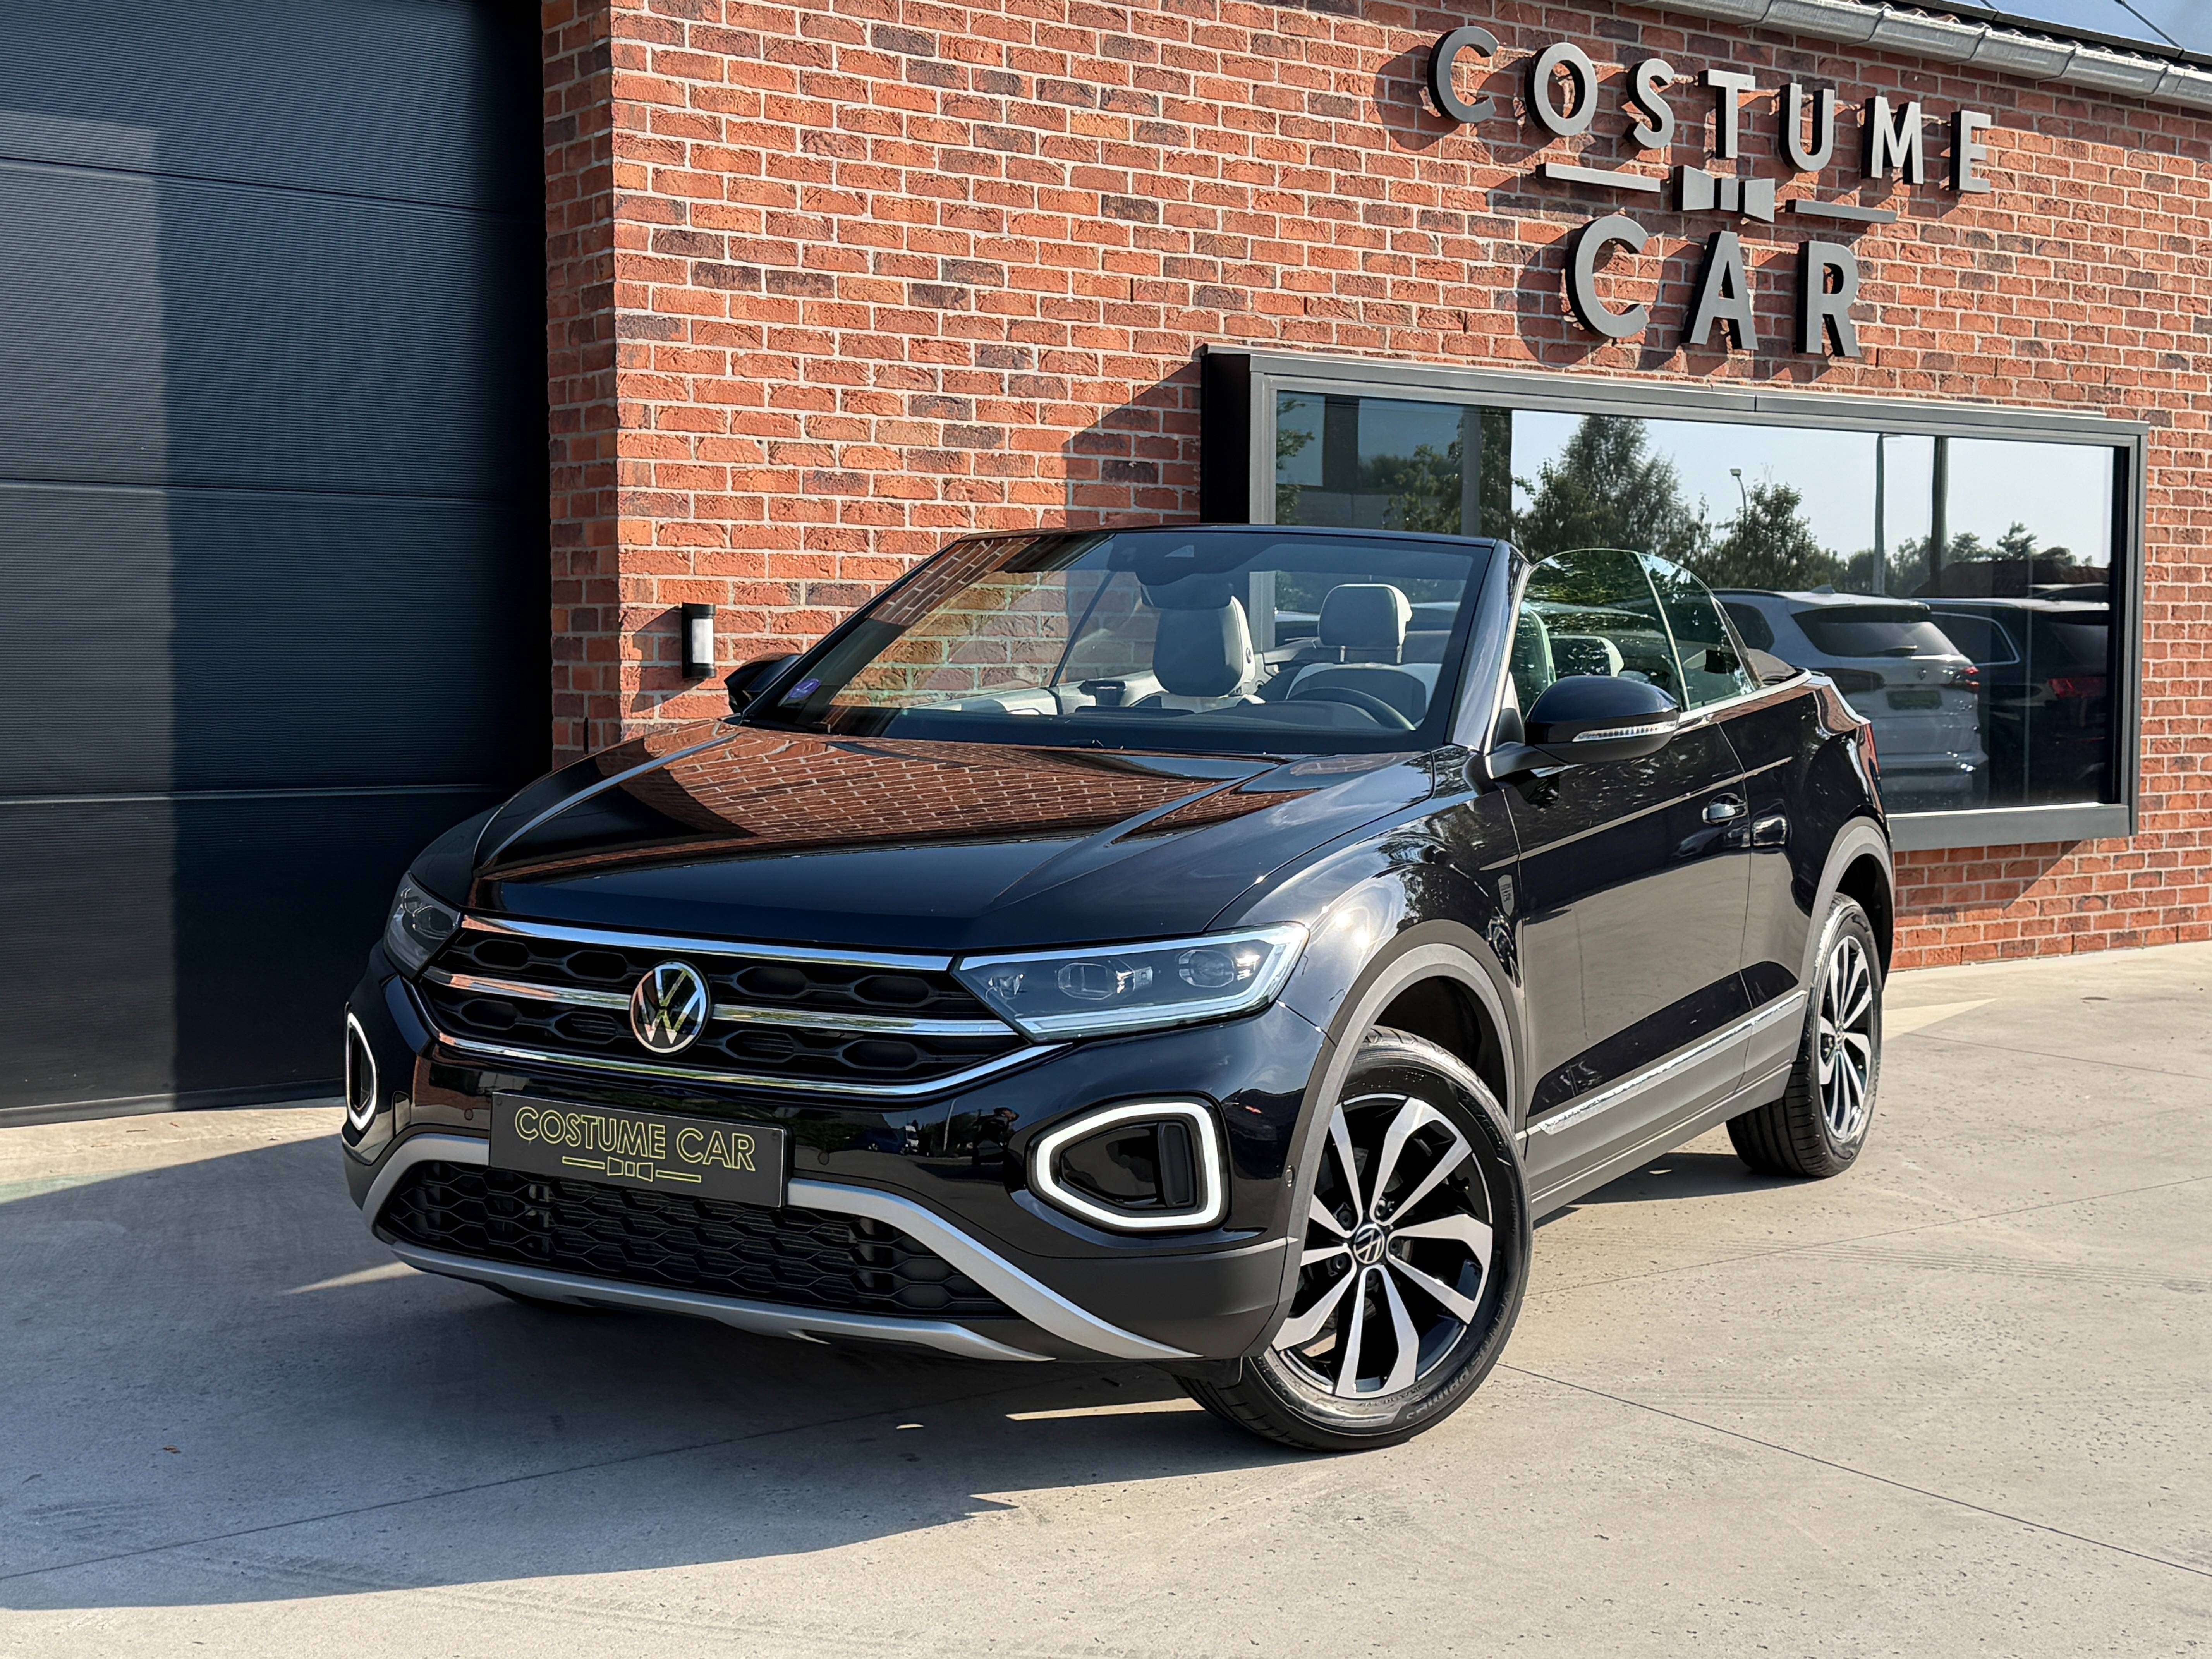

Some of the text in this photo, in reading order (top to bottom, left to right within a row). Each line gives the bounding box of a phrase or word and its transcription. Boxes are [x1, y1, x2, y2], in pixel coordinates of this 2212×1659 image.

[1427, 26, 1992, 193] COSTUME
[1565, 215, 1862, 357] CAR
[515, 1106, 756, 1171] COSTUME CAR
